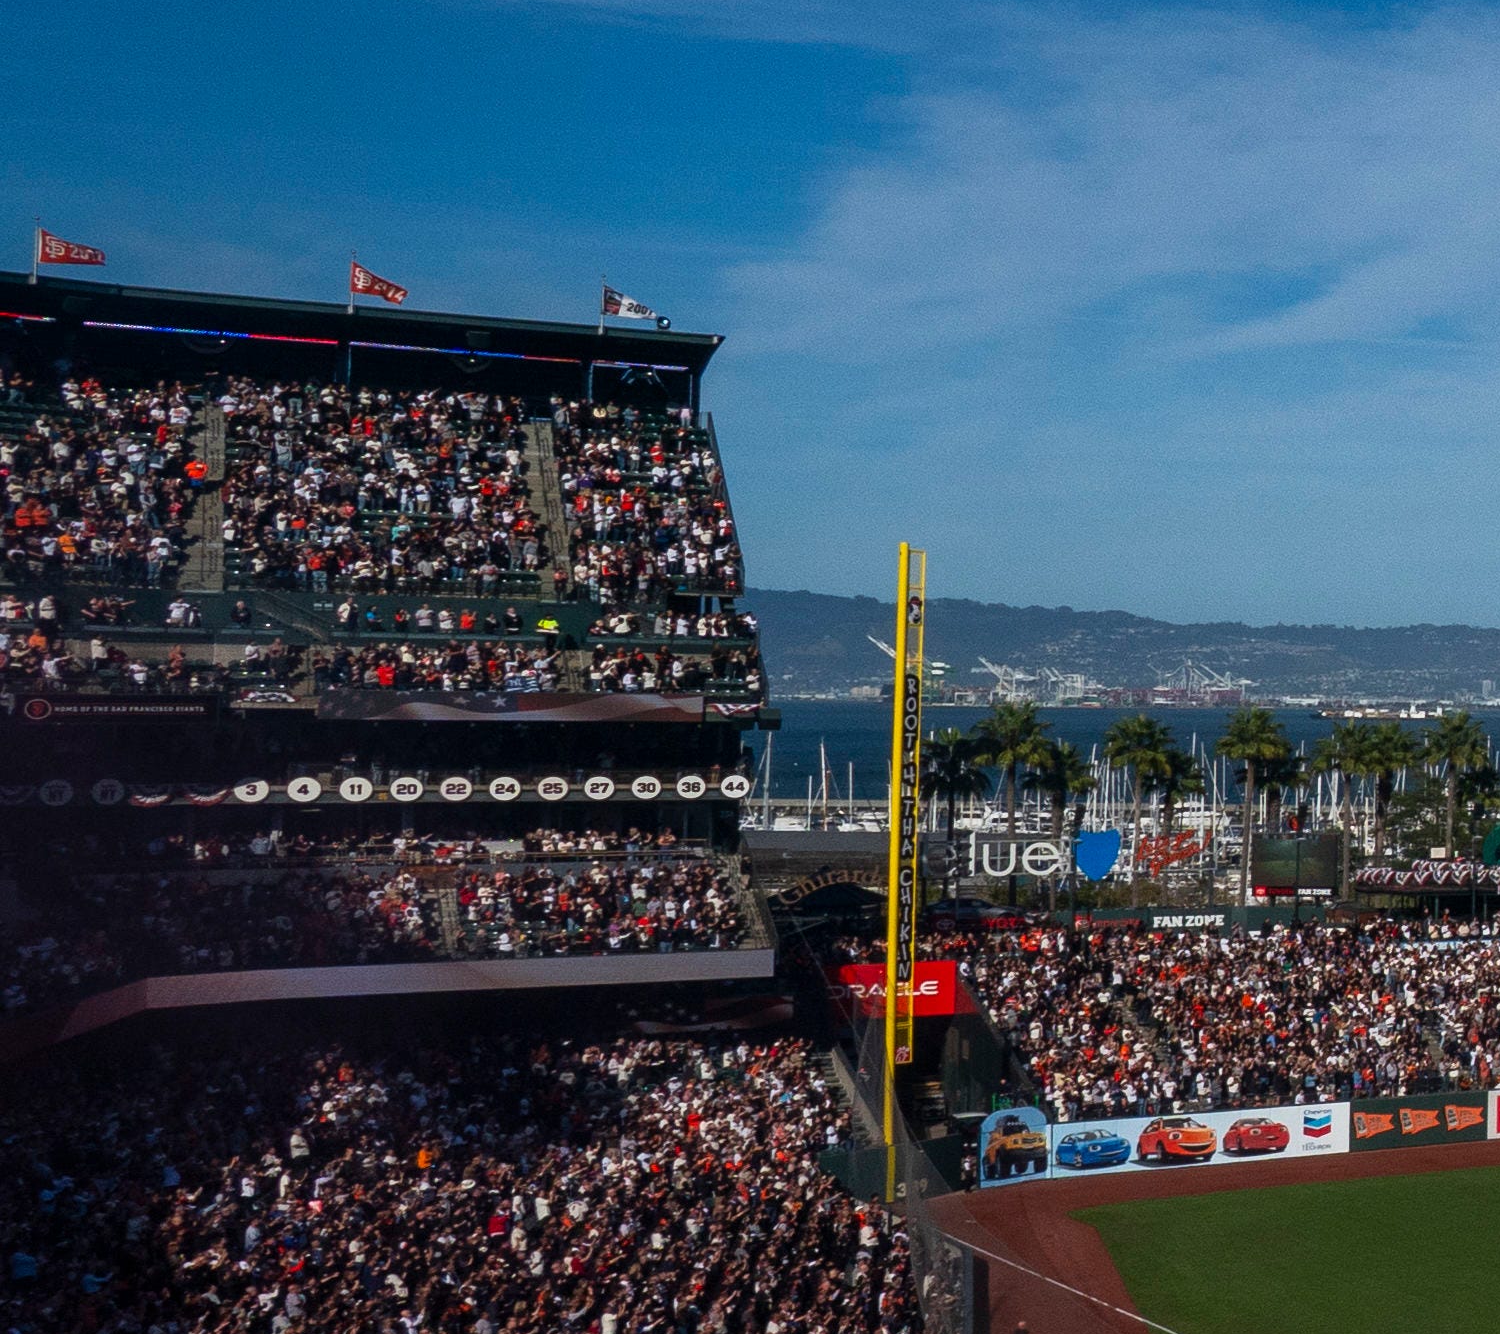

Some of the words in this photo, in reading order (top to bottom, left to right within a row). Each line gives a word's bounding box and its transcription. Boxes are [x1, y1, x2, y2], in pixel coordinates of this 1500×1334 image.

[246, 784, 257, 796] 3
[297, 783, 309, 795] 4
[349, 783, 362, 795] 11
[396, 783, 418, 795] 20
[445, 783, 467, 794] 22
[494, 783, 516, 794] 24
[542, 782, 563, 794] 25
[590, 782, 610, 794] 27
[681, 781, 701, 793] 36
[724, 781, 745, 793] 44
[950, 831, 1061, 877] lue
[899, 870, 913, 978] CHIKIN
[1153, 915, 1184, 928] FAN
[1185, 914, 1225, 927] ZONE
